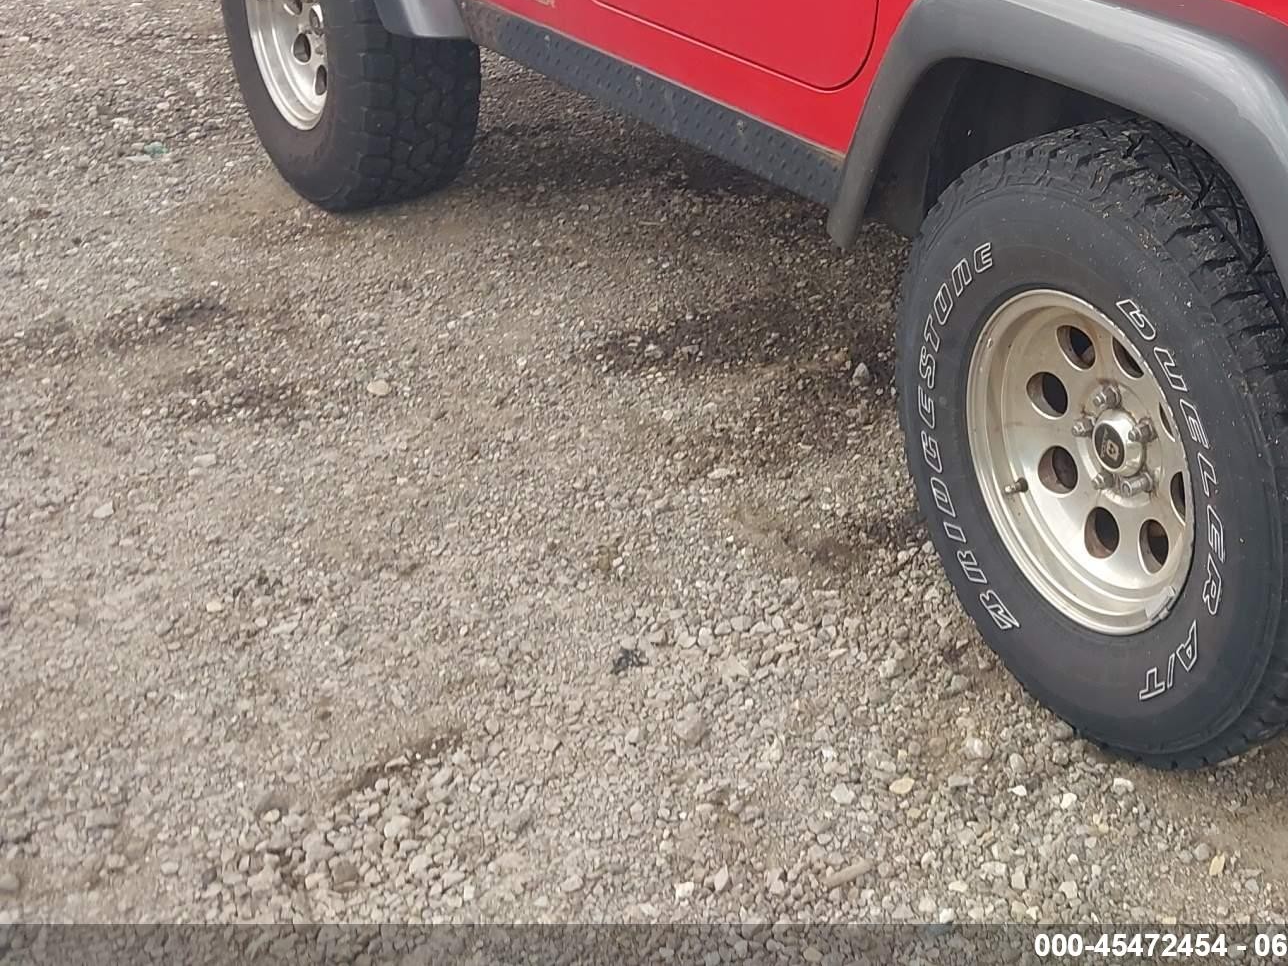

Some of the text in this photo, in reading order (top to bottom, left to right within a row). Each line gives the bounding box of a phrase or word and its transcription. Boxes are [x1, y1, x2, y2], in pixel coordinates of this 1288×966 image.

[917, 242, 1021, 631] BRIDGESTONE
[1116, 299, 1225, 701] DUELER A/T
